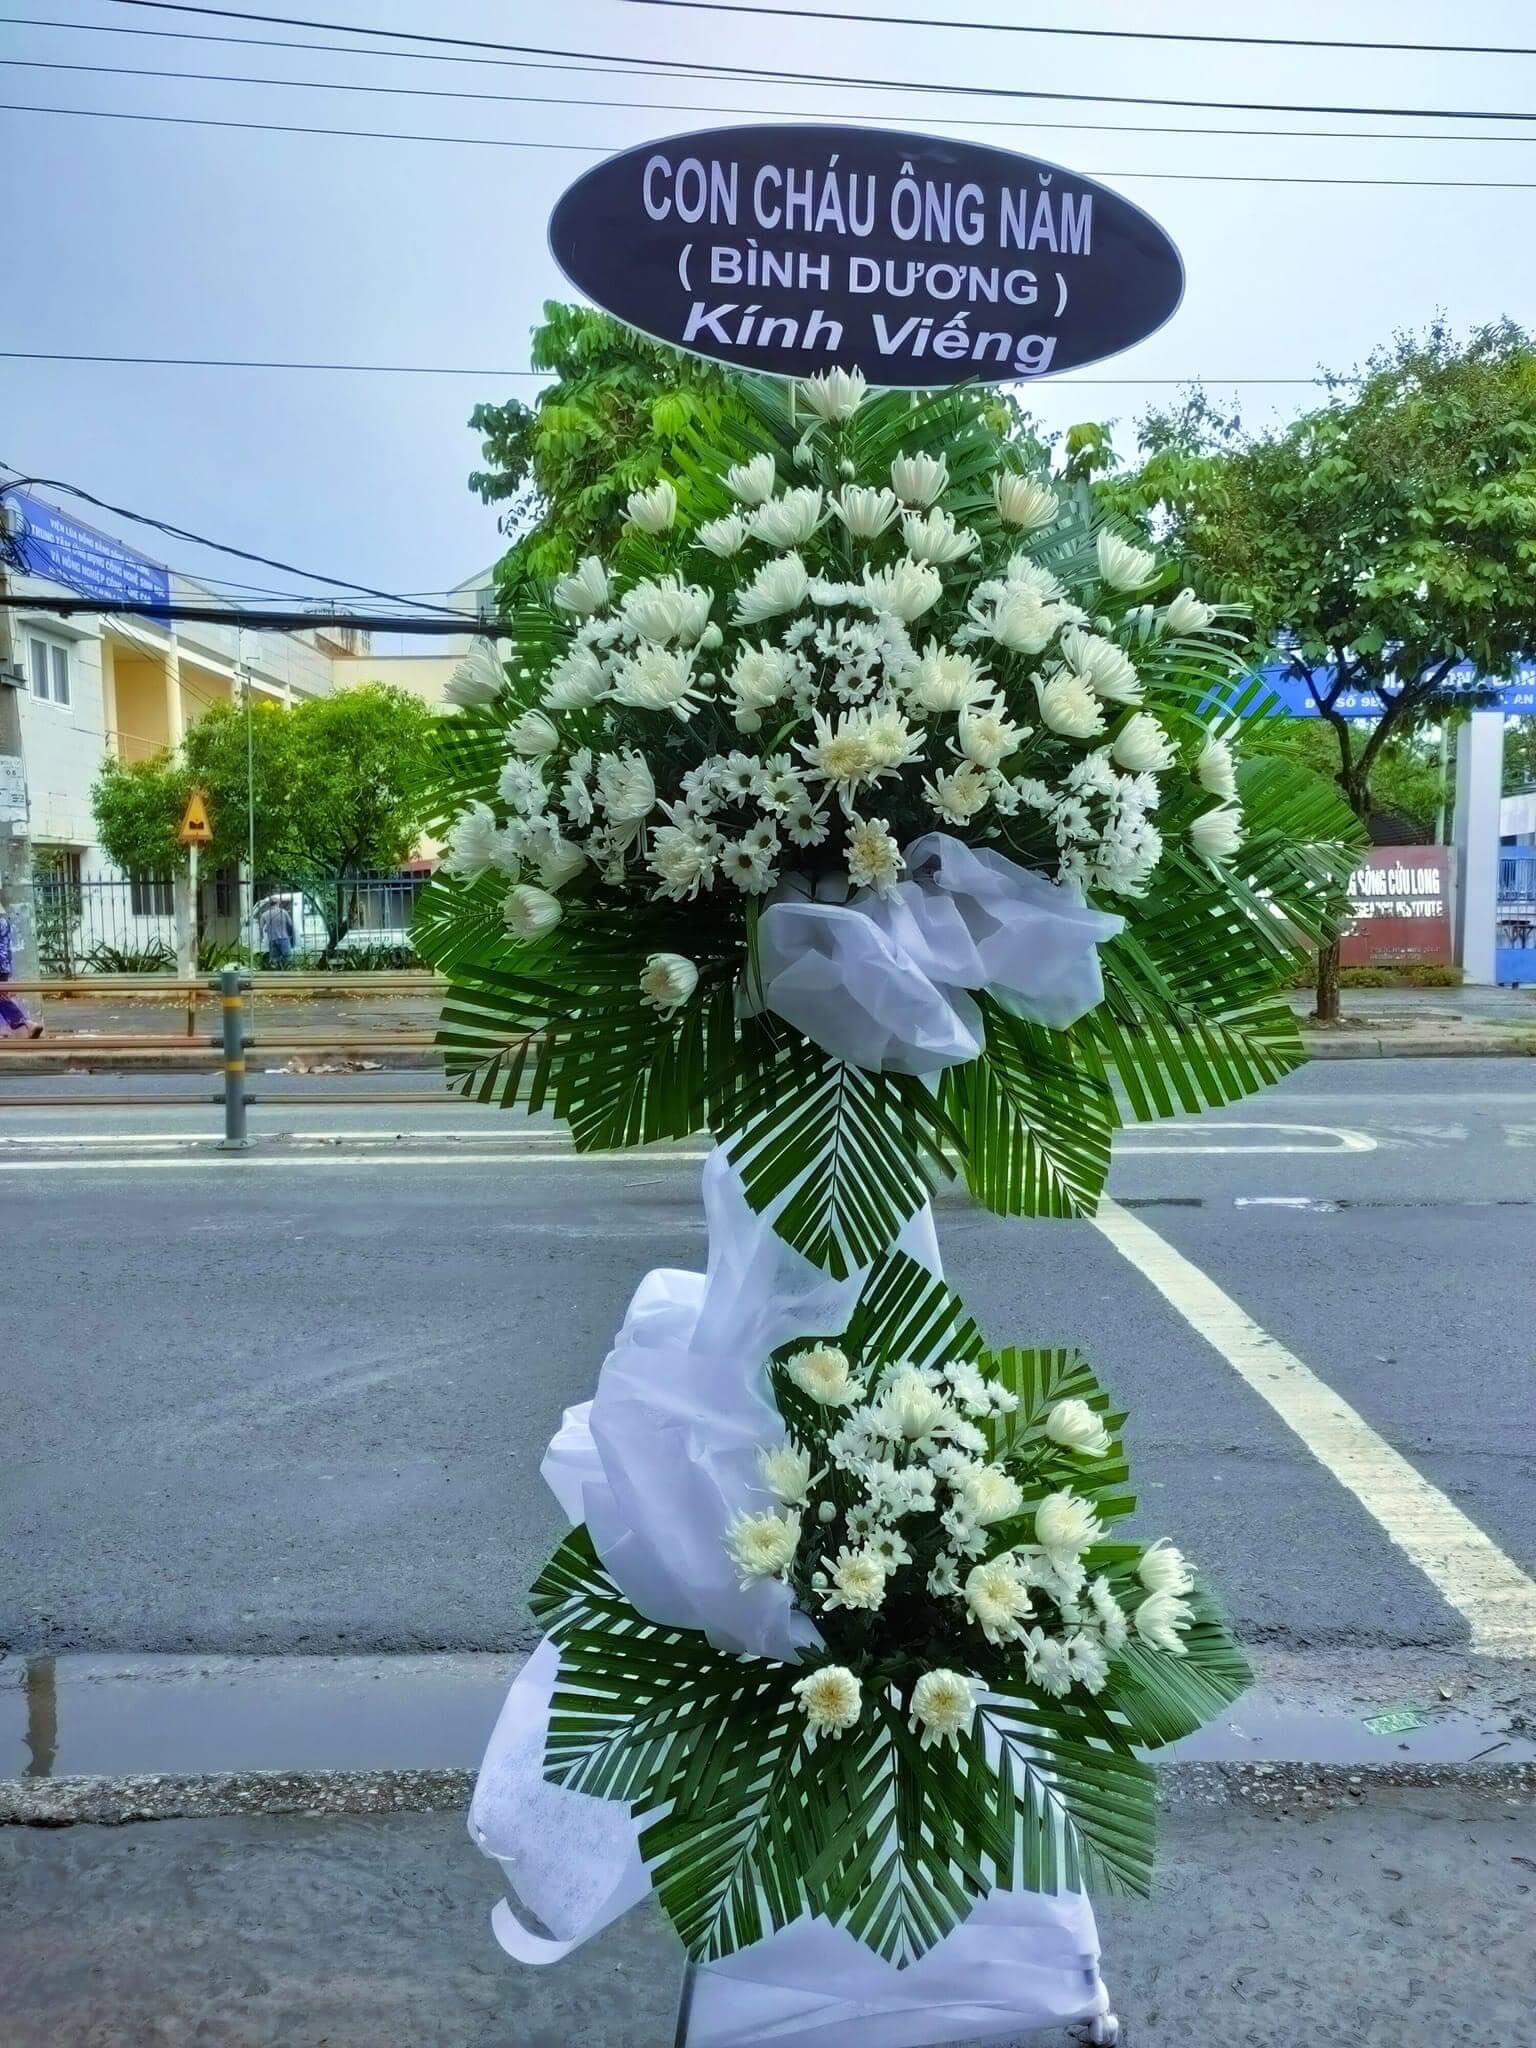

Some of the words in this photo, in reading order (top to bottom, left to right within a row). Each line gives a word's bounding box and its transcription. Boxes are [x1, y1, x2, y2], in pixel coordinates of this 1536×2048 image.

[643, 155, 738, 225] CON
[754, 154, 875, 237] CHÁU
[891, 161, 984, 245] ÔNG
[1000, 173, 1093, 255] NĂM
[711, 239, 829, 290] BÌNH
[849, 257, 1038, 304] DƯƠNG
[682, 302, 843, 350] Kính
[872, 312, 1057, 373] Viếng
[1357, 865, 1386, 895] SÔNG
[1388, 860, 1410, 895] CỬU
[1411, 868, 1440, 894] LONG
